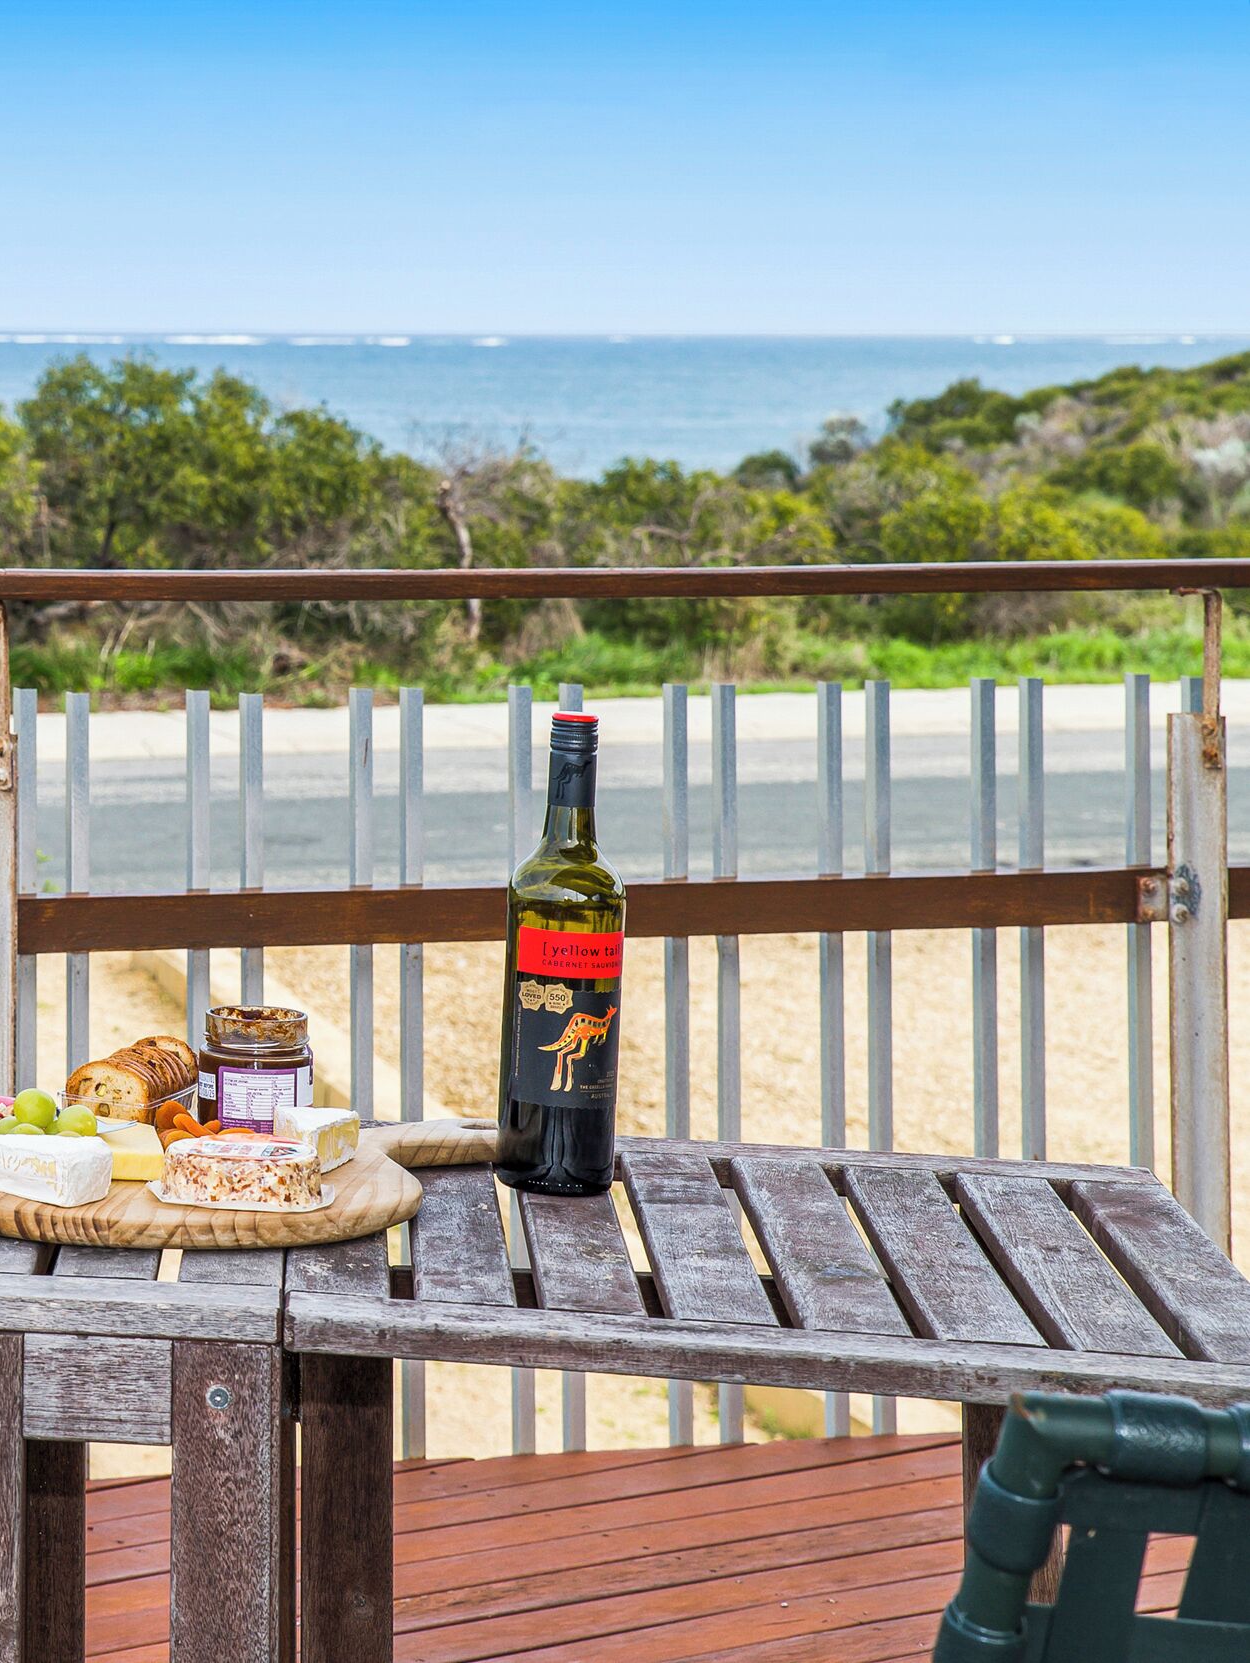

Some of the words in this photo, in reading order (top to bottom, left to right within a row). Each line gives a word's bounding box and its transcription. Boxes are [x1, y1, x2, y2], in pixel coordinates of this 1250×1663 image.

[552, 945, 600, 958] yellow
[542, 959, 588, 969] CABERNET
[521, 992, 542, 1000] LOVED
[549, 993, 566, 1002] 550
